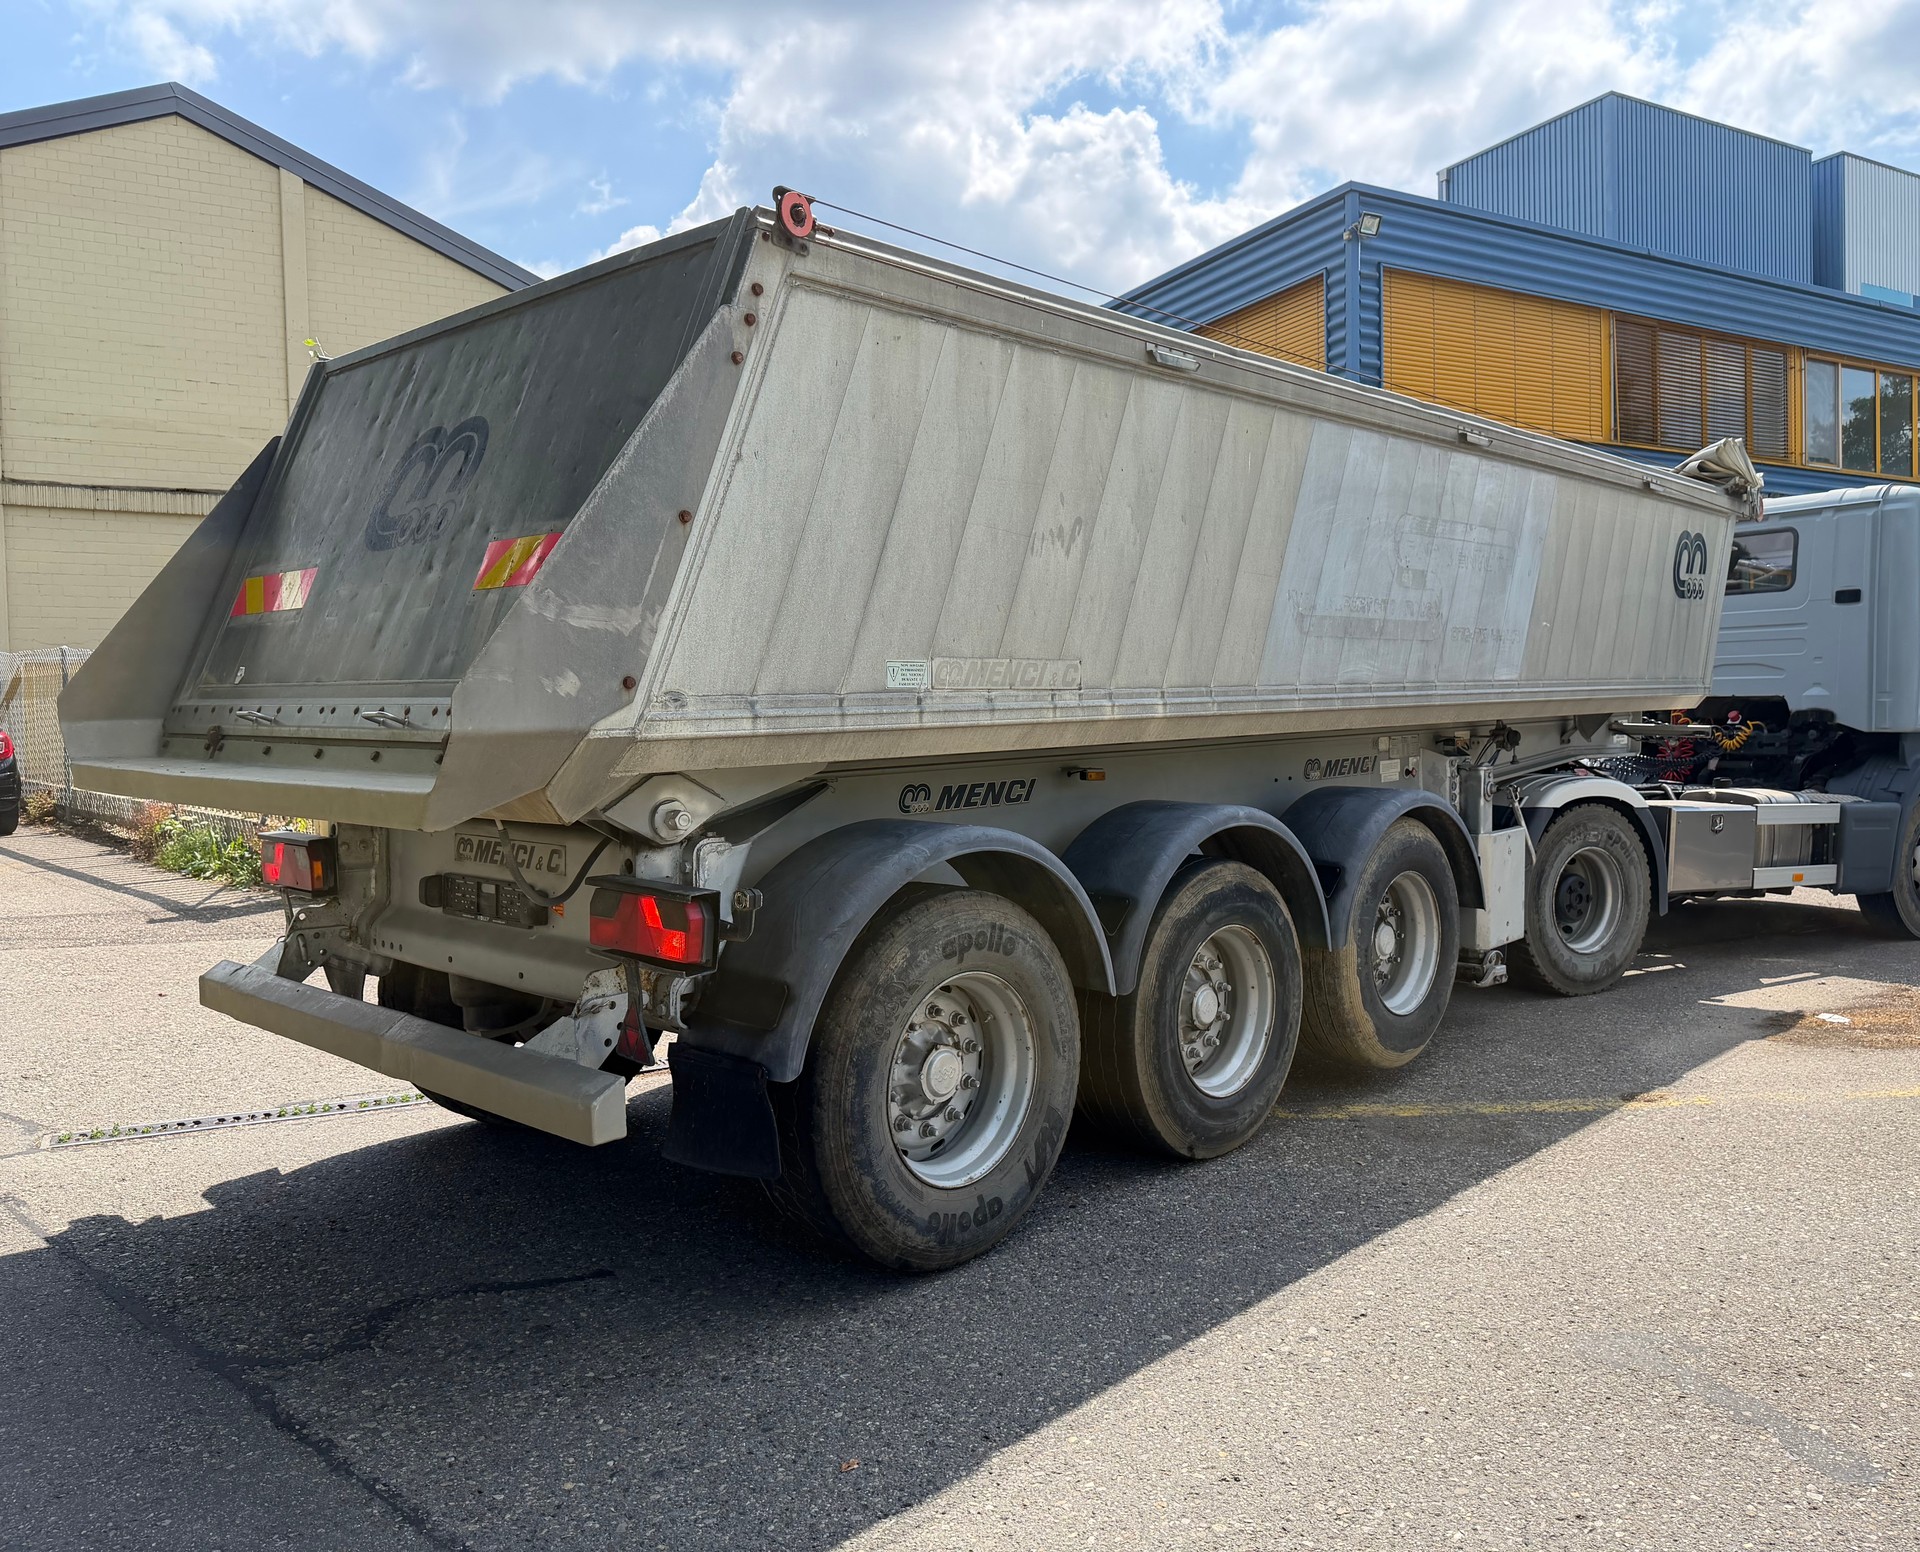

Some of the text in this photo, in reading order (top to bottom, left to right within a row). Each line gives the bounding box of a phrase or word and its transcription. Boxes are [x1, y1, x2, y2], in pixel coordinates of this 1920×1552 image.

[963, 661, 1048, 687] MENCI
[1061, 663, 1079, 687] C
[1322, 755, 1378, 778] MENCI
[935, 778, 1037, 811] MENCI
[535, 855, 544, 871] &
[546, 848, 562, 873] C
[941, 921, 1016, 964] apollo
[927, 1193, 1004, 1245] apollo
